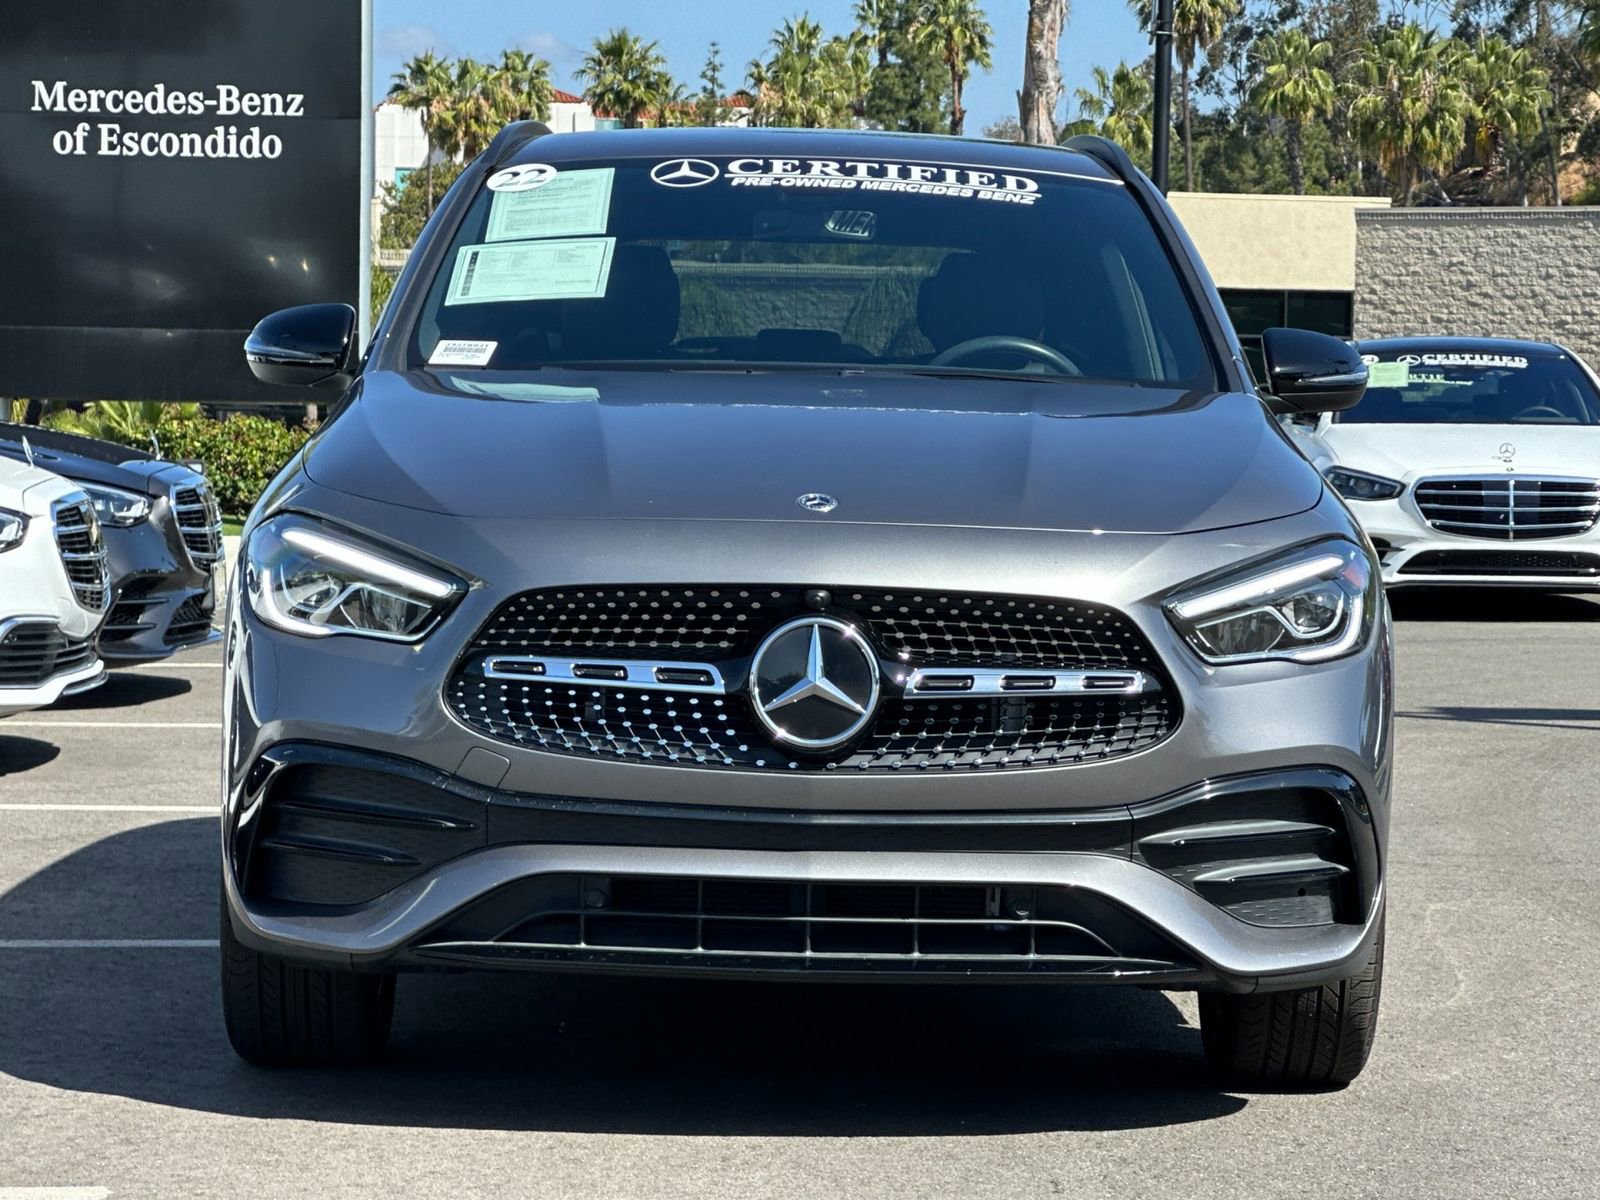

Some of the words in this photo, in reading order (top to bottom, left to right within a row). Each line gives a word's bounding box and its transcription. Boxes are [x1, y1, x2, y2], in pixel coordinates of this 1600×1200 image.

[31, 80, 304, 116] Mercedes-Benz
[53, 122, 90, 154] of
[97, 123, 282, 159] Escondido
[495, 169, 547, 188] 22
[728, 158, 1039, 193] CERTIFIED
[731, 176, 857, 190] PRE-OWNED
[860, 181, 974, 198] MERCEDES
[977, 191, 1036, 205] BENZ
[1421, 353, 1528, 366] CERTIFIED
